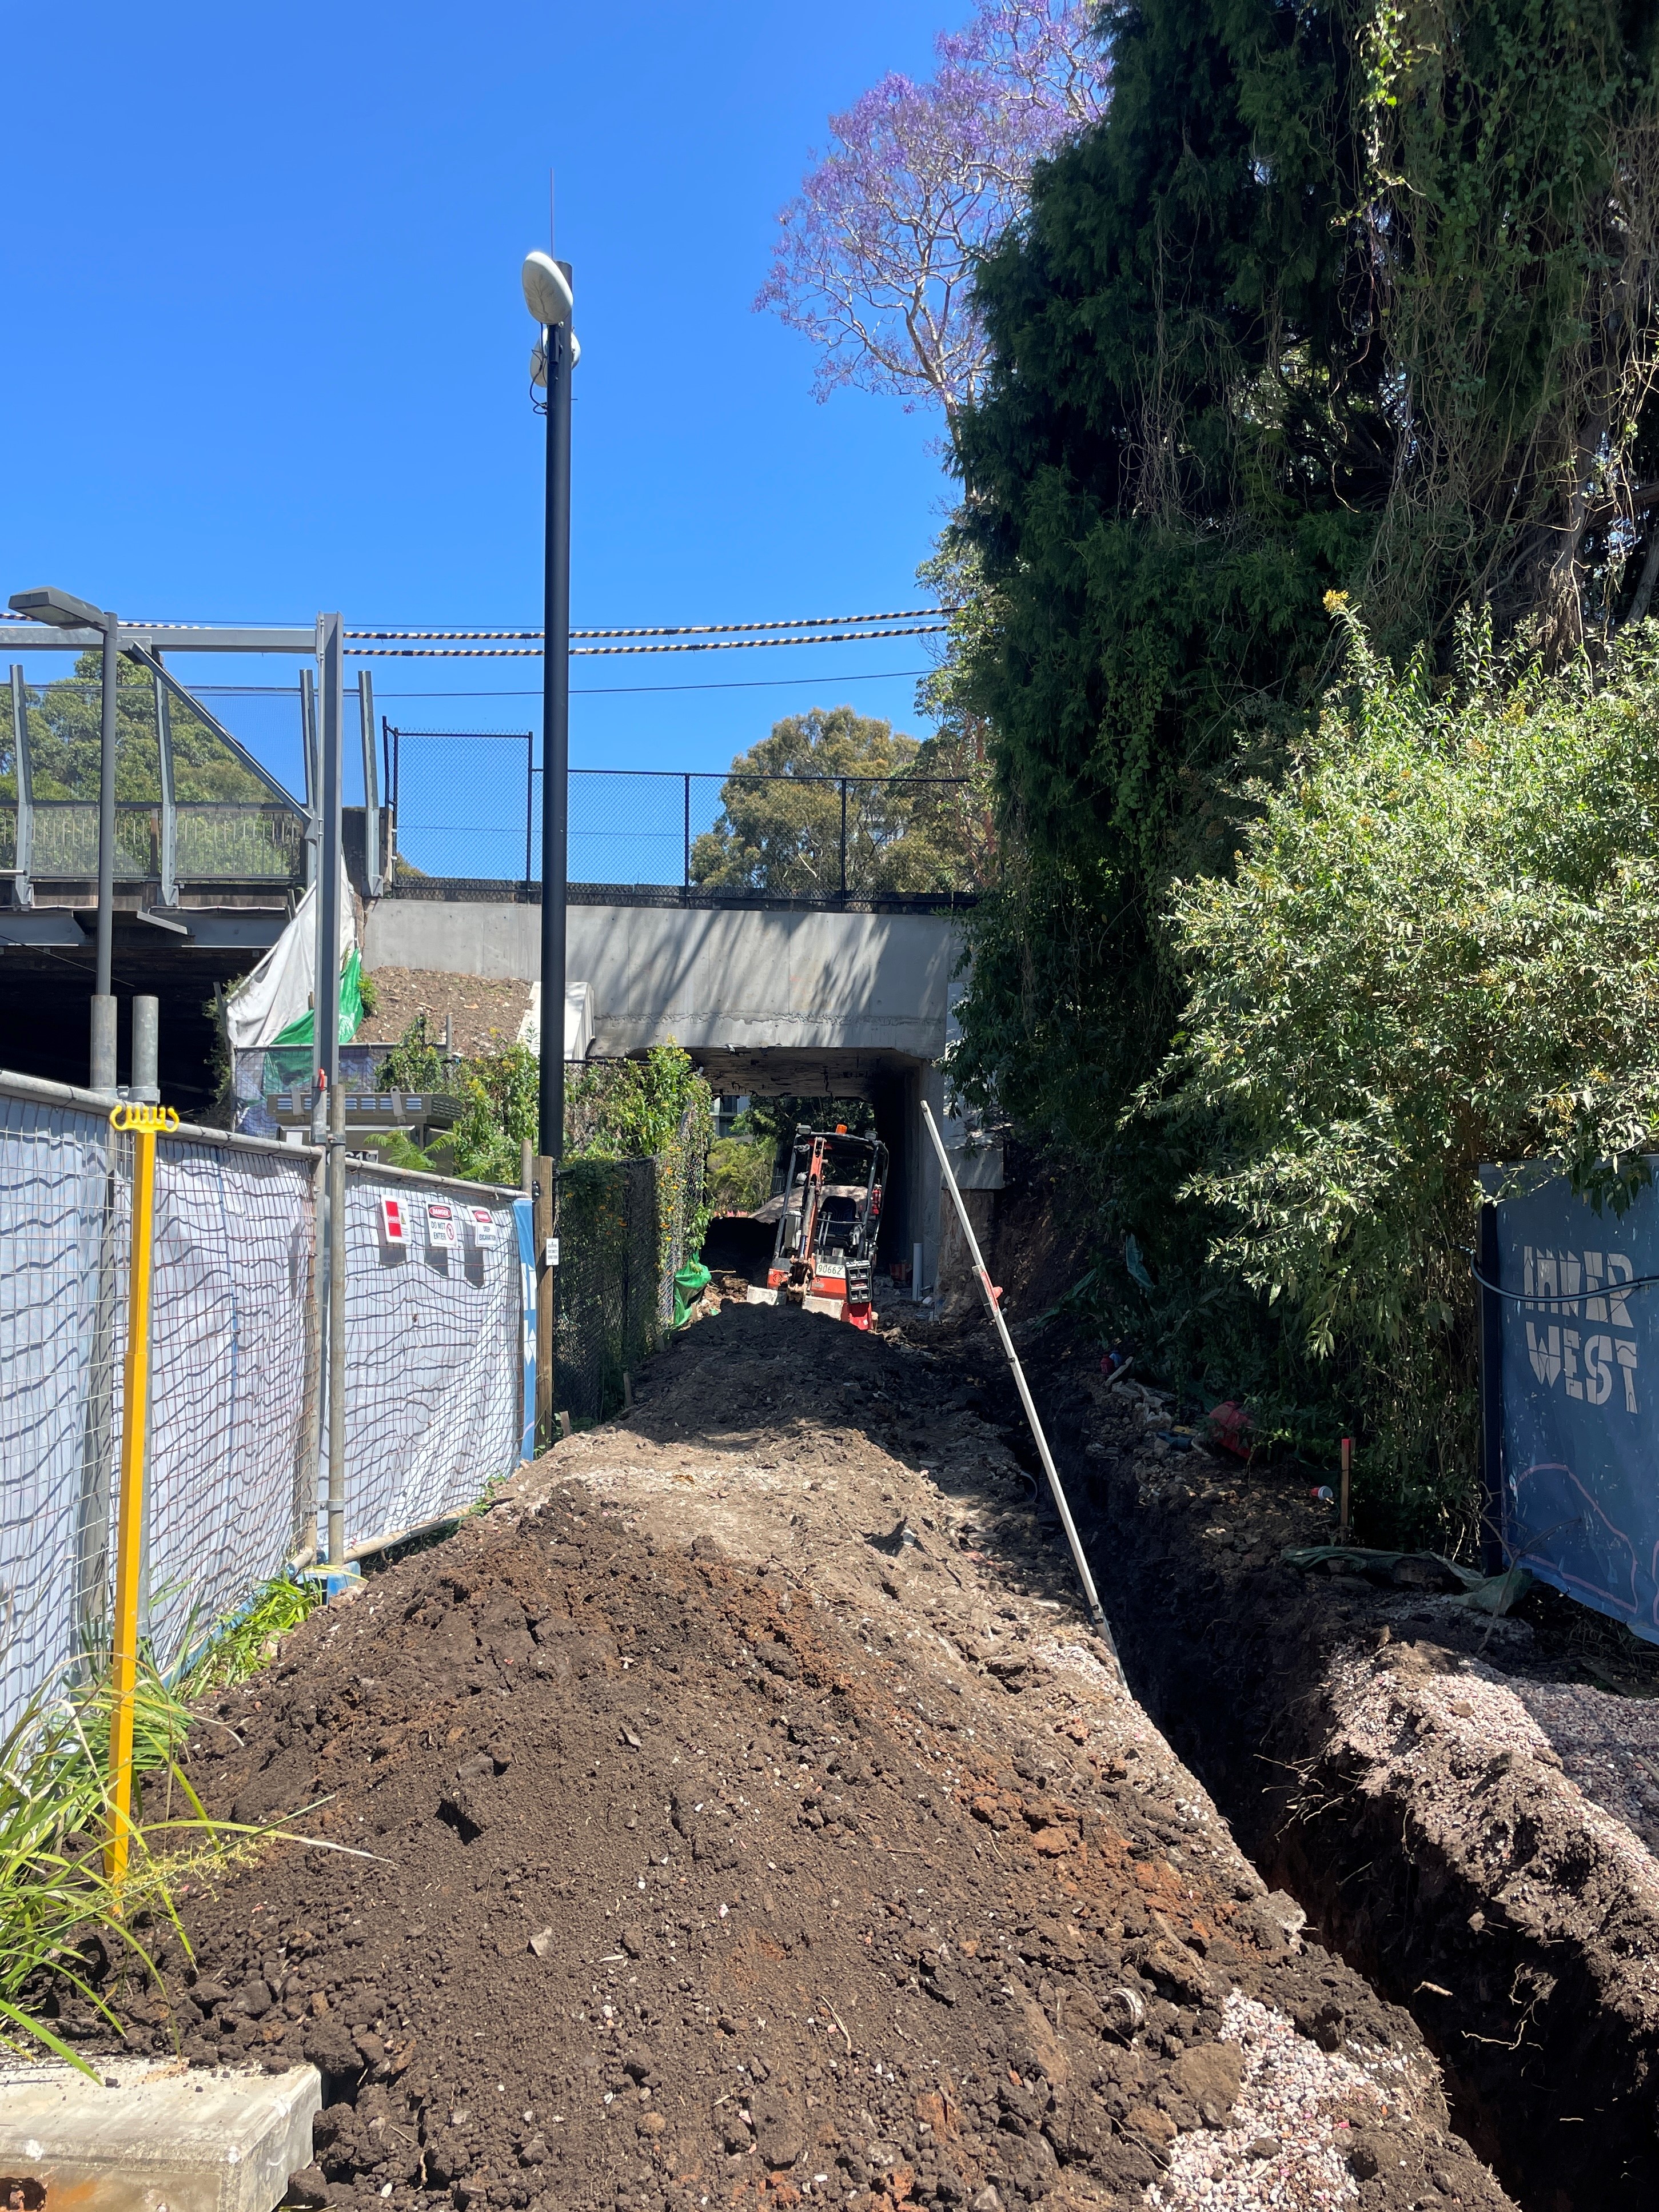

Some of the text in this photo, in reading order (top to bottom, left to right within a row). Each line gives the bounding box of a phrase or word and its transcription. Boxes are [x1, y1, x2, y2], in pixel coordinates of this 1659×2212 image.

[432, 1208, 449, 1217] DANGER
[431, 1221, 446, 1230] DO NOT
[433, 1231, 446, 1240] ENTER
[1524, 1245, 1634, 1328] INNER
[1525, 1321, 1638, 1415] WEST
